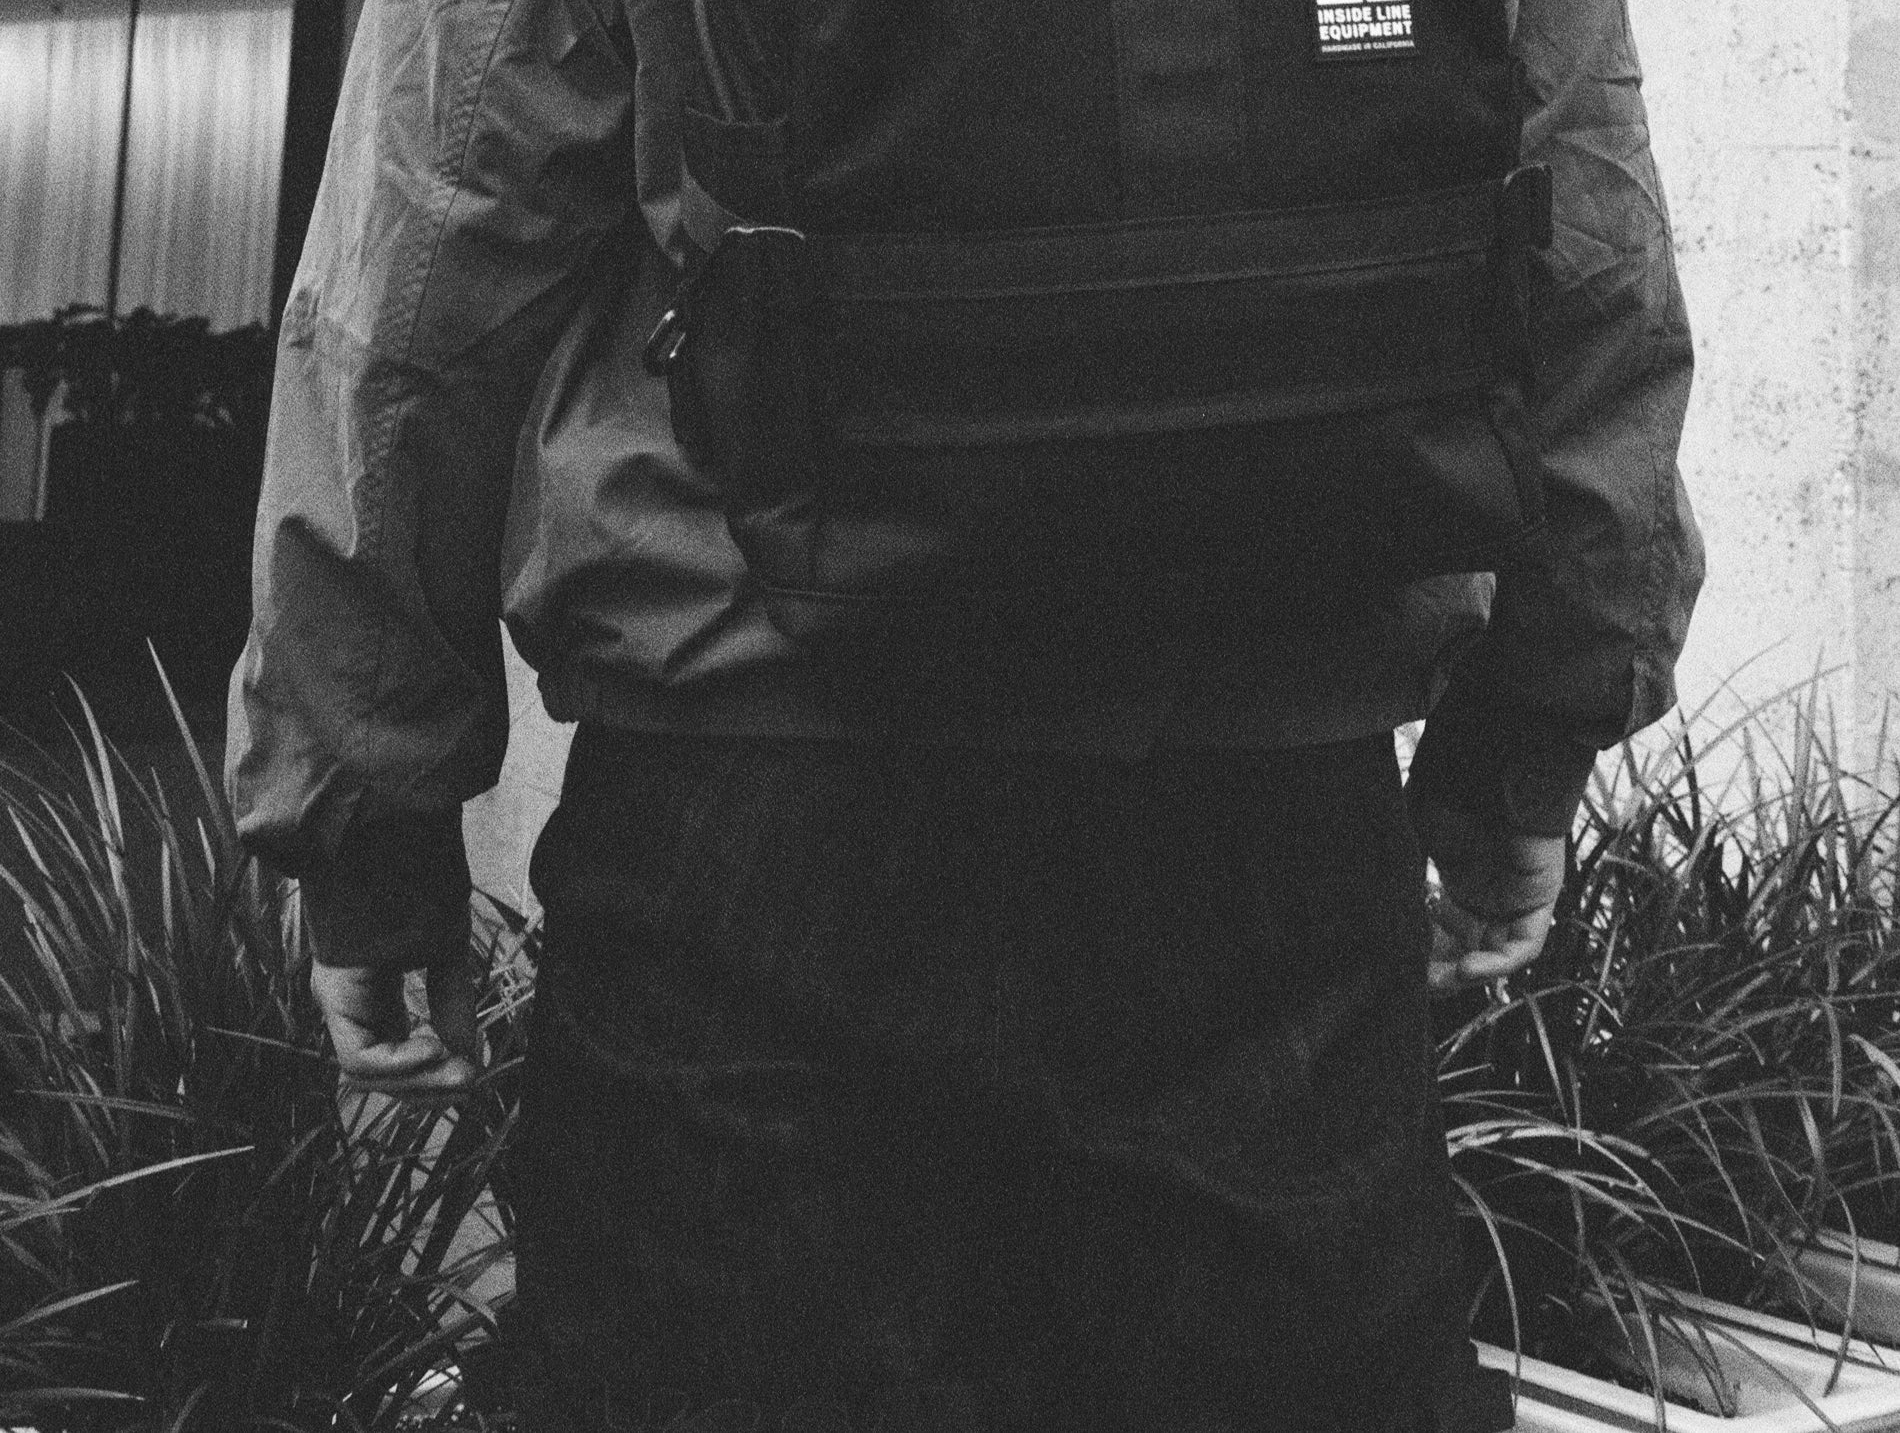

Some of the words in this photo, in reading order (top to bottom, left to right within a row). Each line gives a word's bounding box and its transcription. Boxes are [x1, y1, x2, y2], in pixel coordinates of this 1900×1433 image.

[1318, 6, 1372, 24] INSIDE
[1376, 4, 1411, 21] LINE
[1319, 21, 1412, 41] EQUIPMENT
